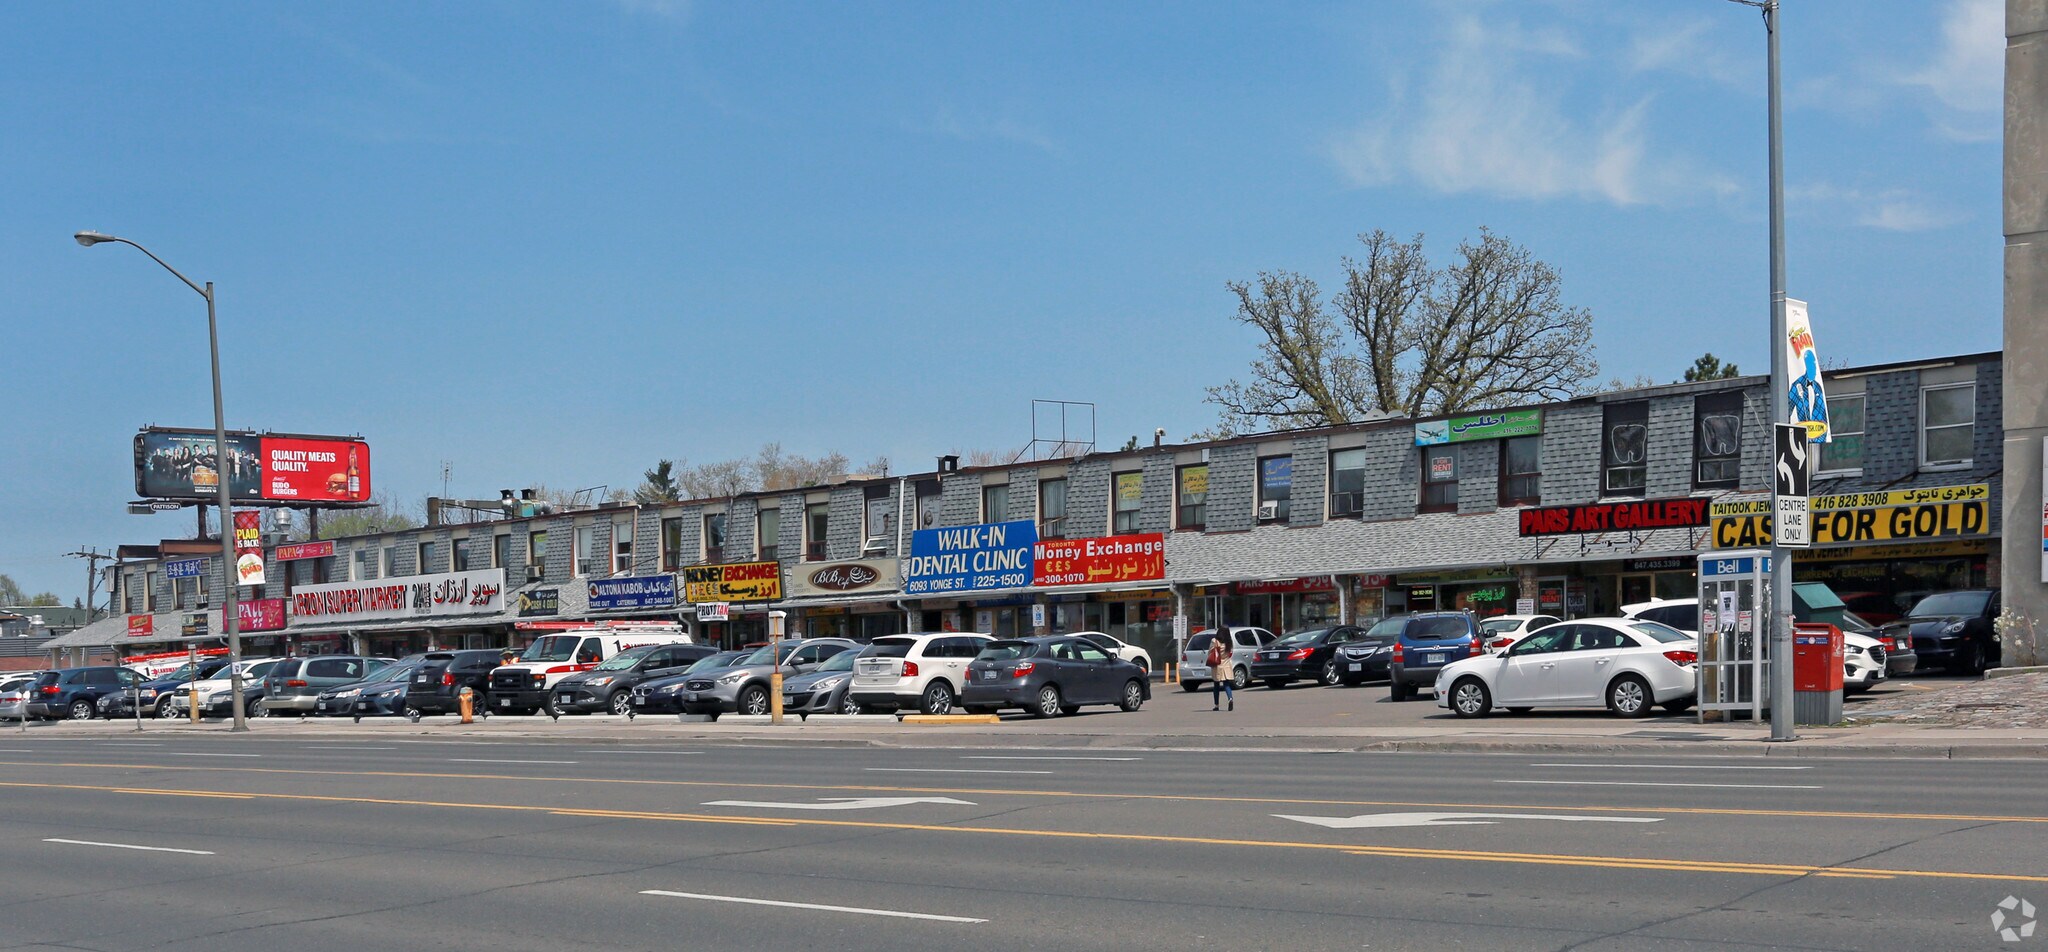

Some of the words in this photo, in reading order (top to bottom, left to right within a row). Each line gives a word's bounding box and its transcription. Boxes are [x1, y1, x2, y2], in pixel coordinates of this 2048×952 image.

[271, 449, 307, 461] QUALITY
[308, 451, 336, 463] MEATS
[271, 461, 309, 472] QUALITY.
[1432, 464, 1452, 472] RENT
[272, 488, 298, 496] BURGERS
[1779, 499, 1806, 512] CENTRE
[1815, 497, 1834, 510] 416
[1838, 494, 1858, 508] 828
[1861, 492, 1889, 506] 3908
[1713, 502, 1751, 515] TAITOOK
[1520, 508, 1569, 534] PARS
[1571, 505, 1612, 531] ART
[1613, 499, 1707, 529] GALLERY
[1784, 514, 1802, 526] LANE
[1717, 515, 1772, 548] CAS
[1812, 509, 1877, 544] FOR
[1889, 501, 1983, 538] GOLD
[236, 528, 259, 540] PLAID
[938, 525, 1007, 551] WALK-IN
[1784, 528, 1802, 541] ONLY
[237, 540, 243, 548] IS
[243, 539, 260, 548] BACK!
[1047, 541, 1076, 549] TORONTO
[278, 547, 297, 558] PAPA
[1034, 544, 1081, 561] Money
[1086, 540, 1163, 557] Exchange
[910, 553, 969, 577] DENTAL
[972, 547, 1029, 573] CLINIC
[1634, 560, 1681, 569] 647.435.3399
[1717, 559, 1739, 574] Bell
[685, 566, 724, 583] MONEY
[724, 563, 779, 582] EXCHANGE
[1045, 572, 1085, 584] 300-1070
[598, 583, 622, 596] ALTONA
[621, 582, 643, 595] KABOB
[909, 580, 928, 592] 6093
[929, 578, 953, 590] YONGE
[954, 577, 966, 589] ST.
[976, 573, 1025, 587] 225-1500
[292, 591, 327, 616] ARZON
[326, 589, 363, 615] SUPER
[361, 584, 408, 612] MARKET
[616, 598, 638, 606] CATERING
[1540, 594, 1561, 603] RENT
[144, 667, 150, 676] 1
